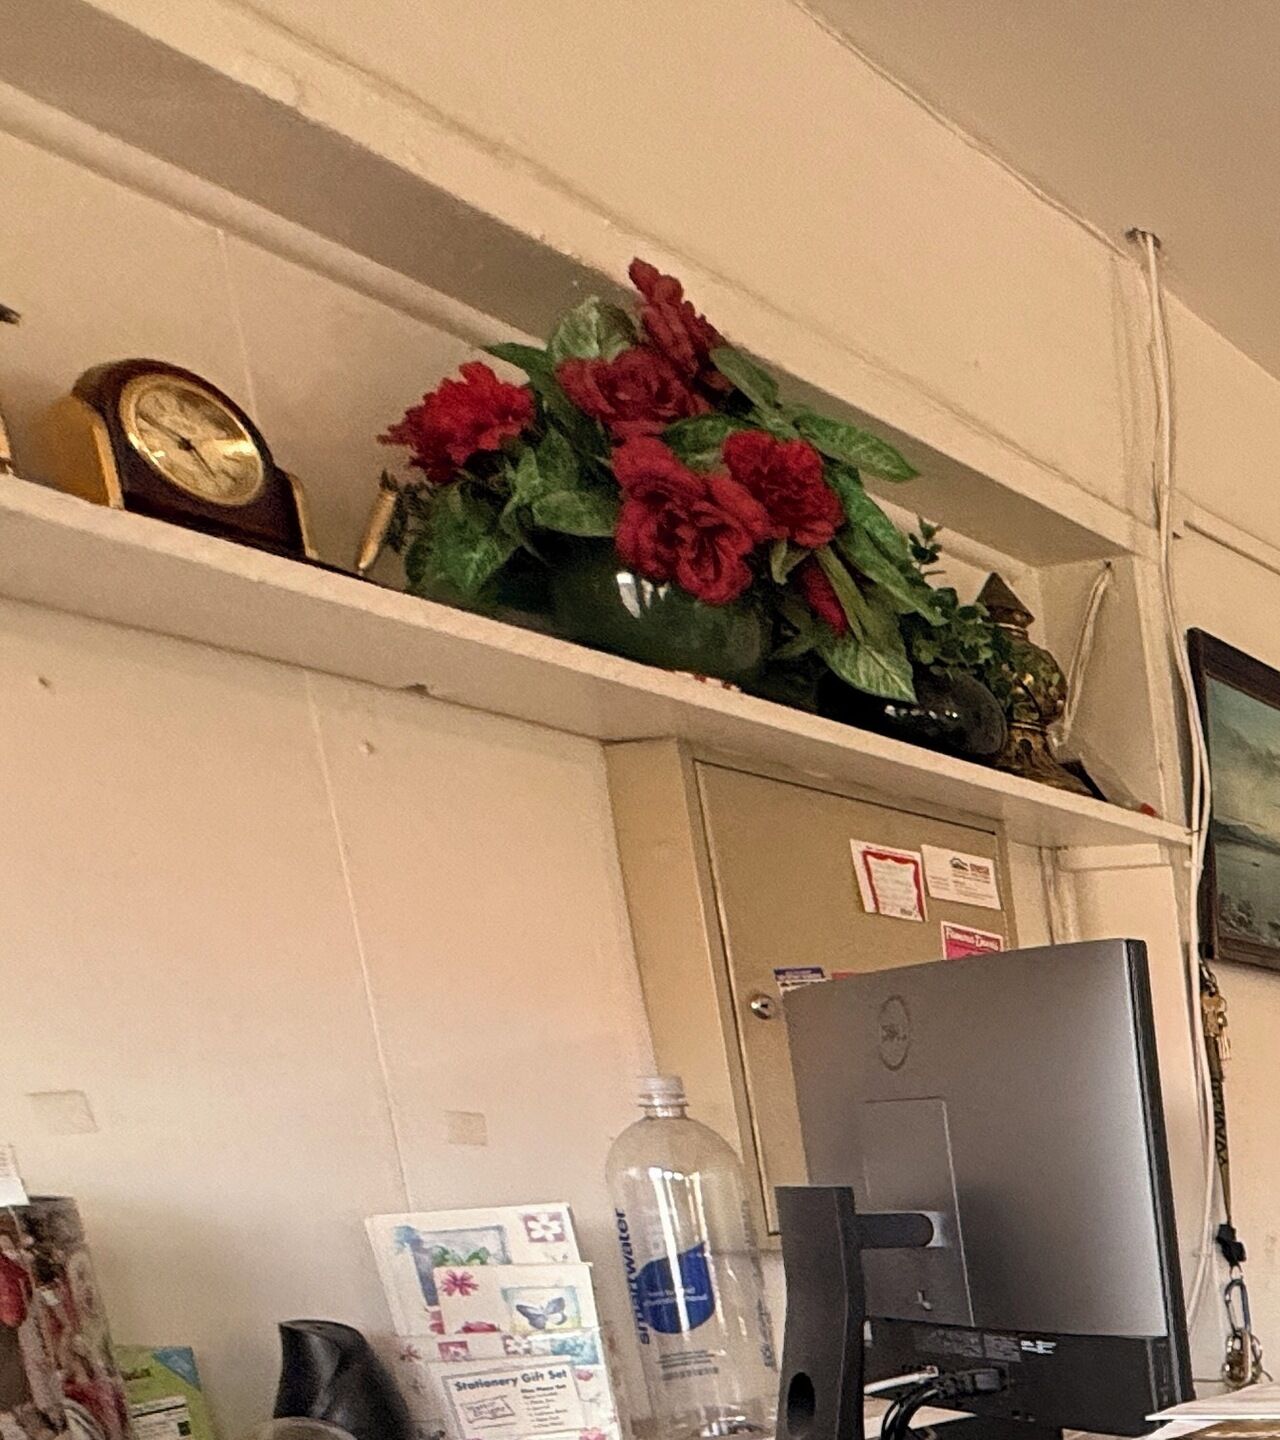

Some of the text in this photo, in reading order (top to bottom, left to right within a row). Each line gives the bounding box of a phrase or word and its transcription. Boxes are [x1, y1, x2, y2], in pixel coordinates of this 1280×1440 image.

[454, 1376, 518, 1392] Stationery
[521, 1371, 544, 1383] Gift
[548, 1369, 567, 1380] Set
